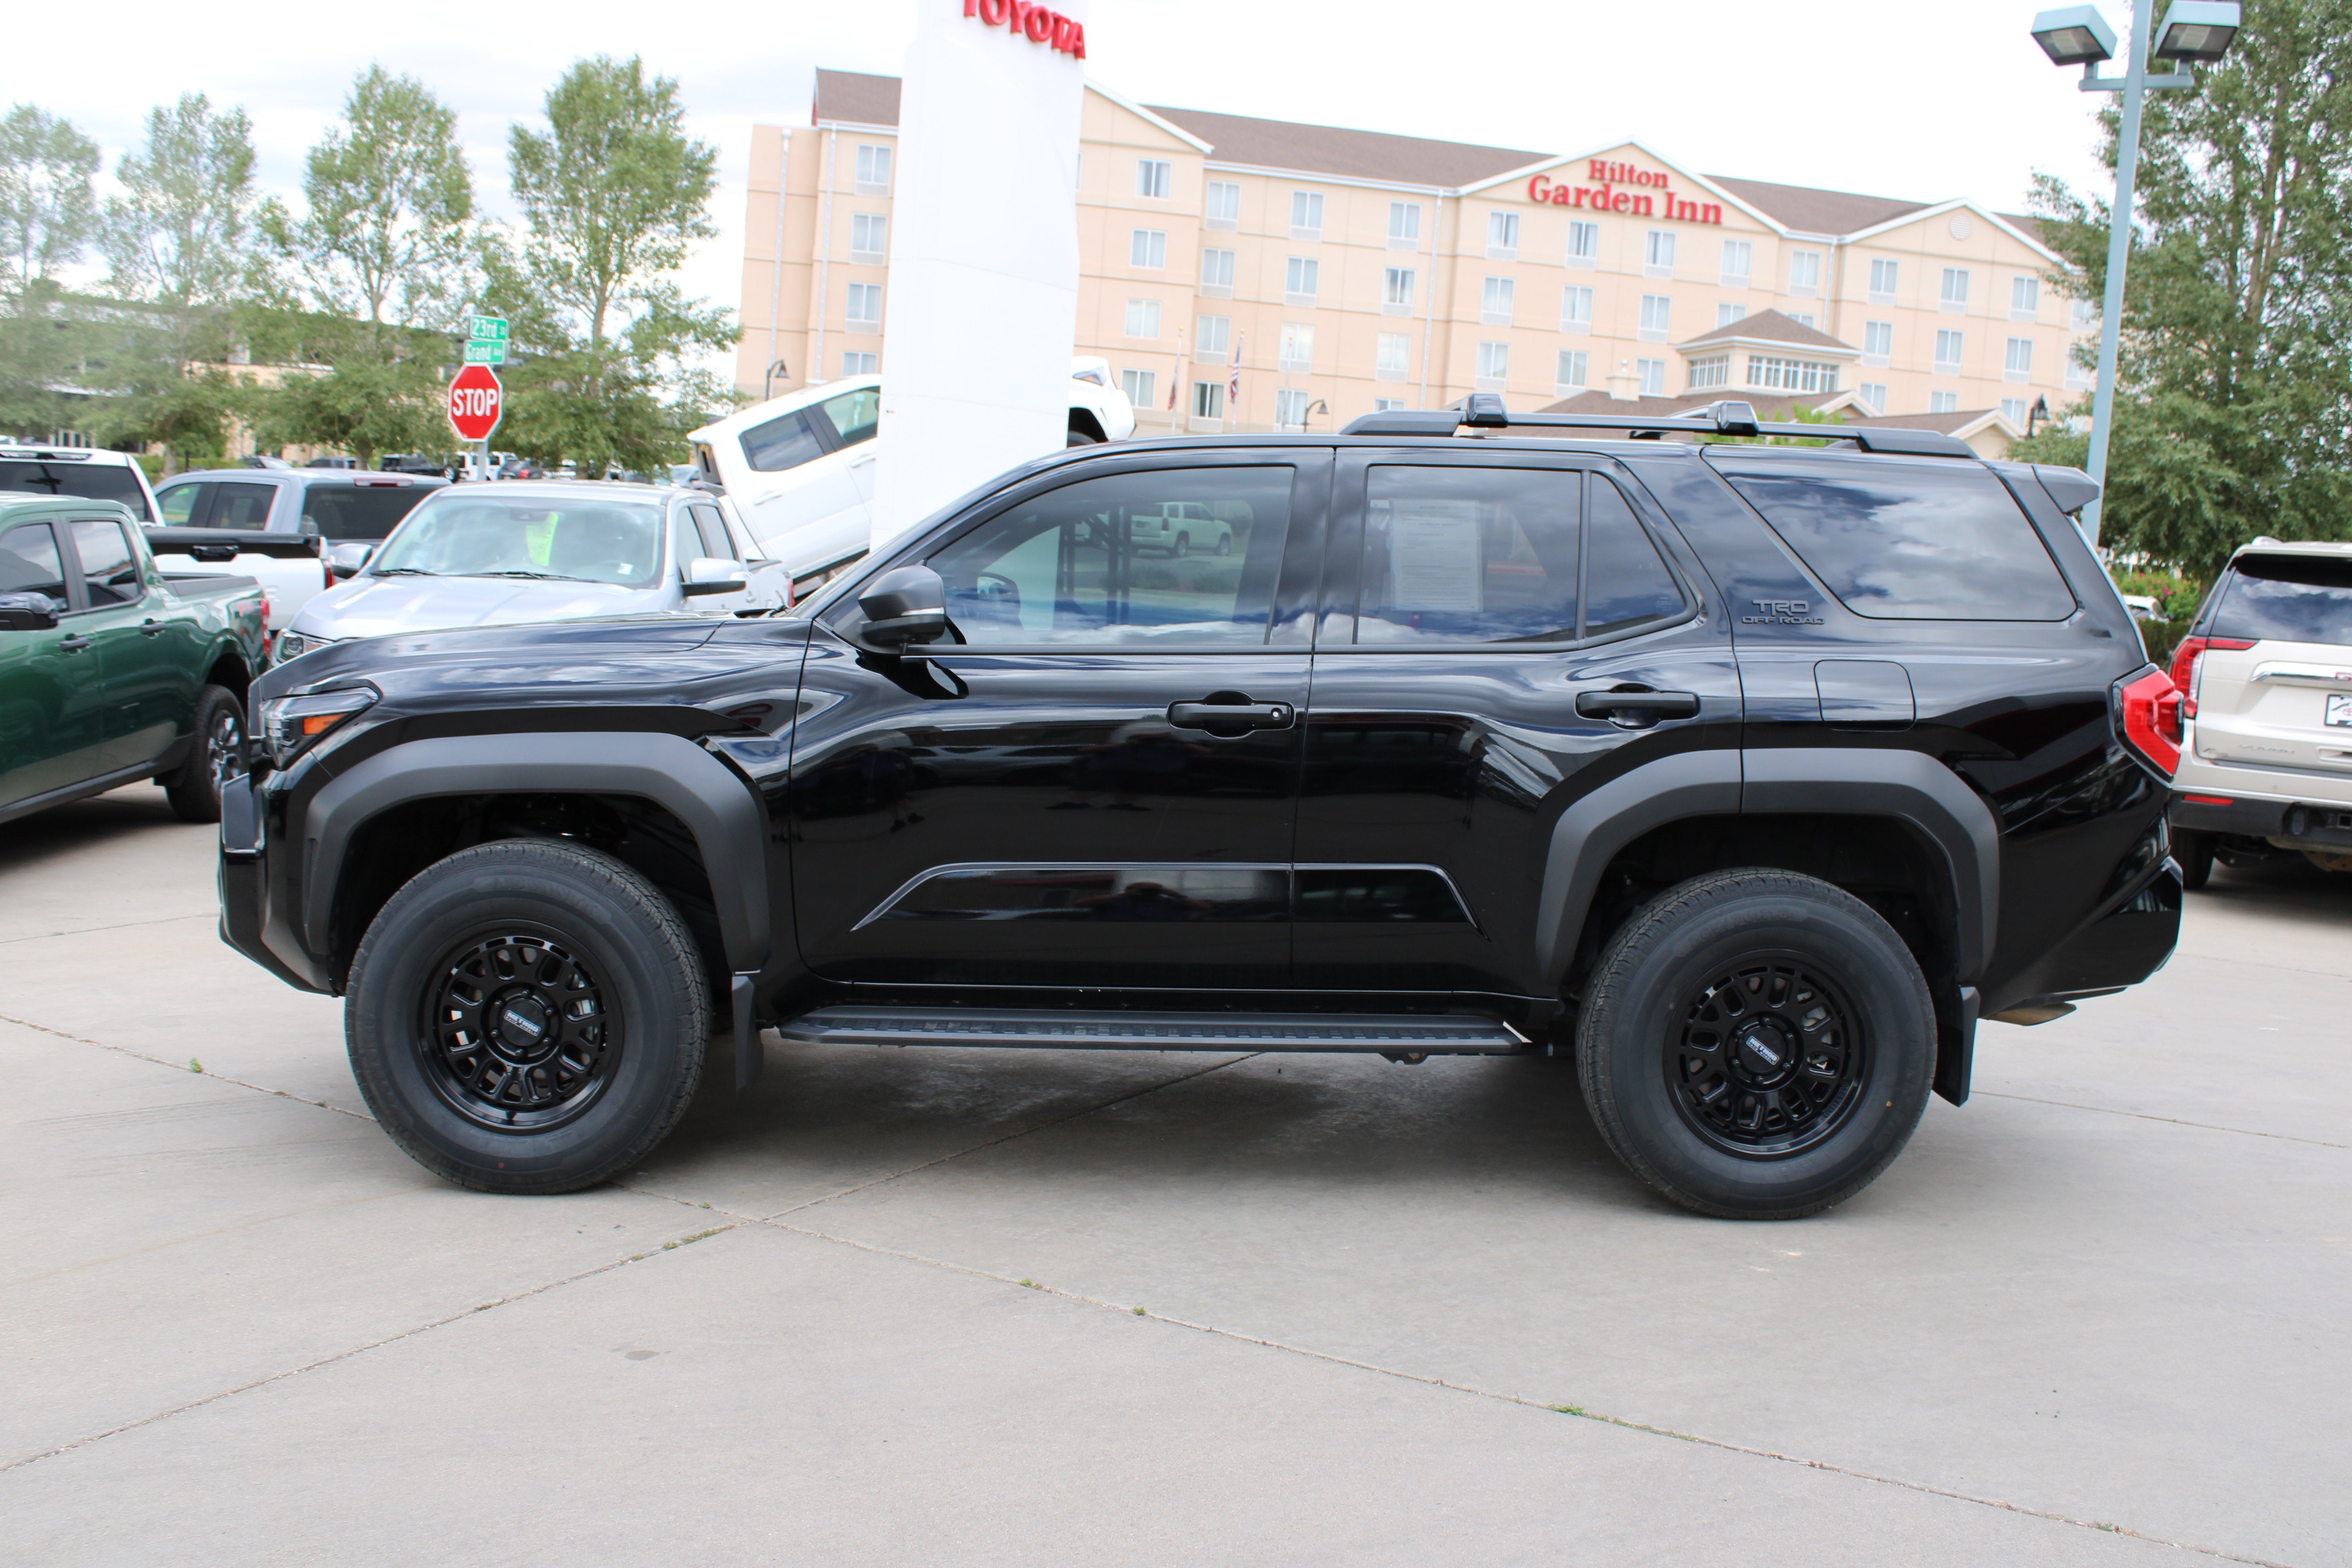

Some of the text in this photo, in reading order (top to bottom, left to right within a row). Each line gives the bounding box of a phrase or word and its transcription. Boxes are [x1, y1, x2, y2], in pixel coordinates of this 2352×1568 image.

[1589, 158, 1669, 188] Hilton
[1529, 174, 1722, 225] Garden Inn
[472, 318, 497, 339] 23rd
[466, 343, 491, 361] Grand
[452, 388, 498, 416] STOP
[1752, 599, 1810, 617] TRD
[1778, 617, 1826, 625] ROAD
[1749, 1038, 1778, 1062] METHOD
